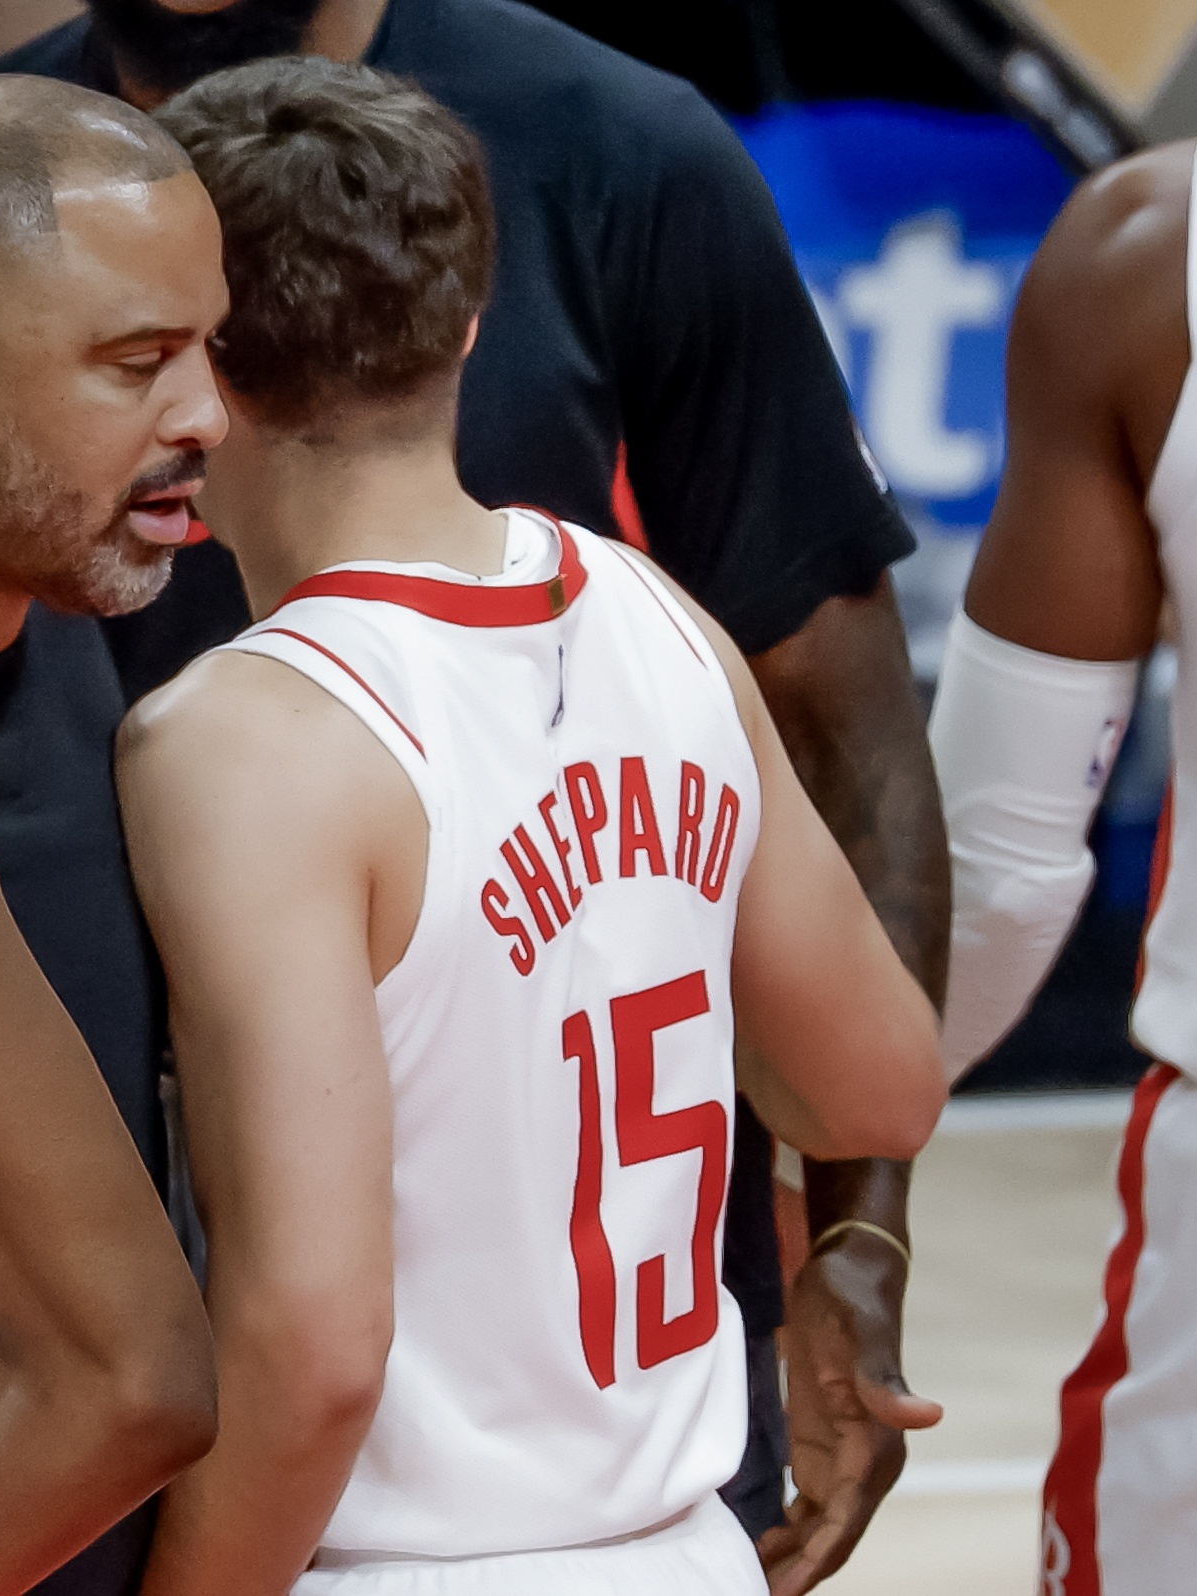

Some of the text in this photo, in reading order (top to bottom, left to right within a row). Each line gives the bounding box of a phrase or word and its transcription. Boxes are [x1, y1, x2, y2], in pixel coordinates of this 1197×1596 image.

[808, 208, 1002, 498] t
[481, 756, 741, 976] SHEPARD
[563, 970, 729, 1389] 15
